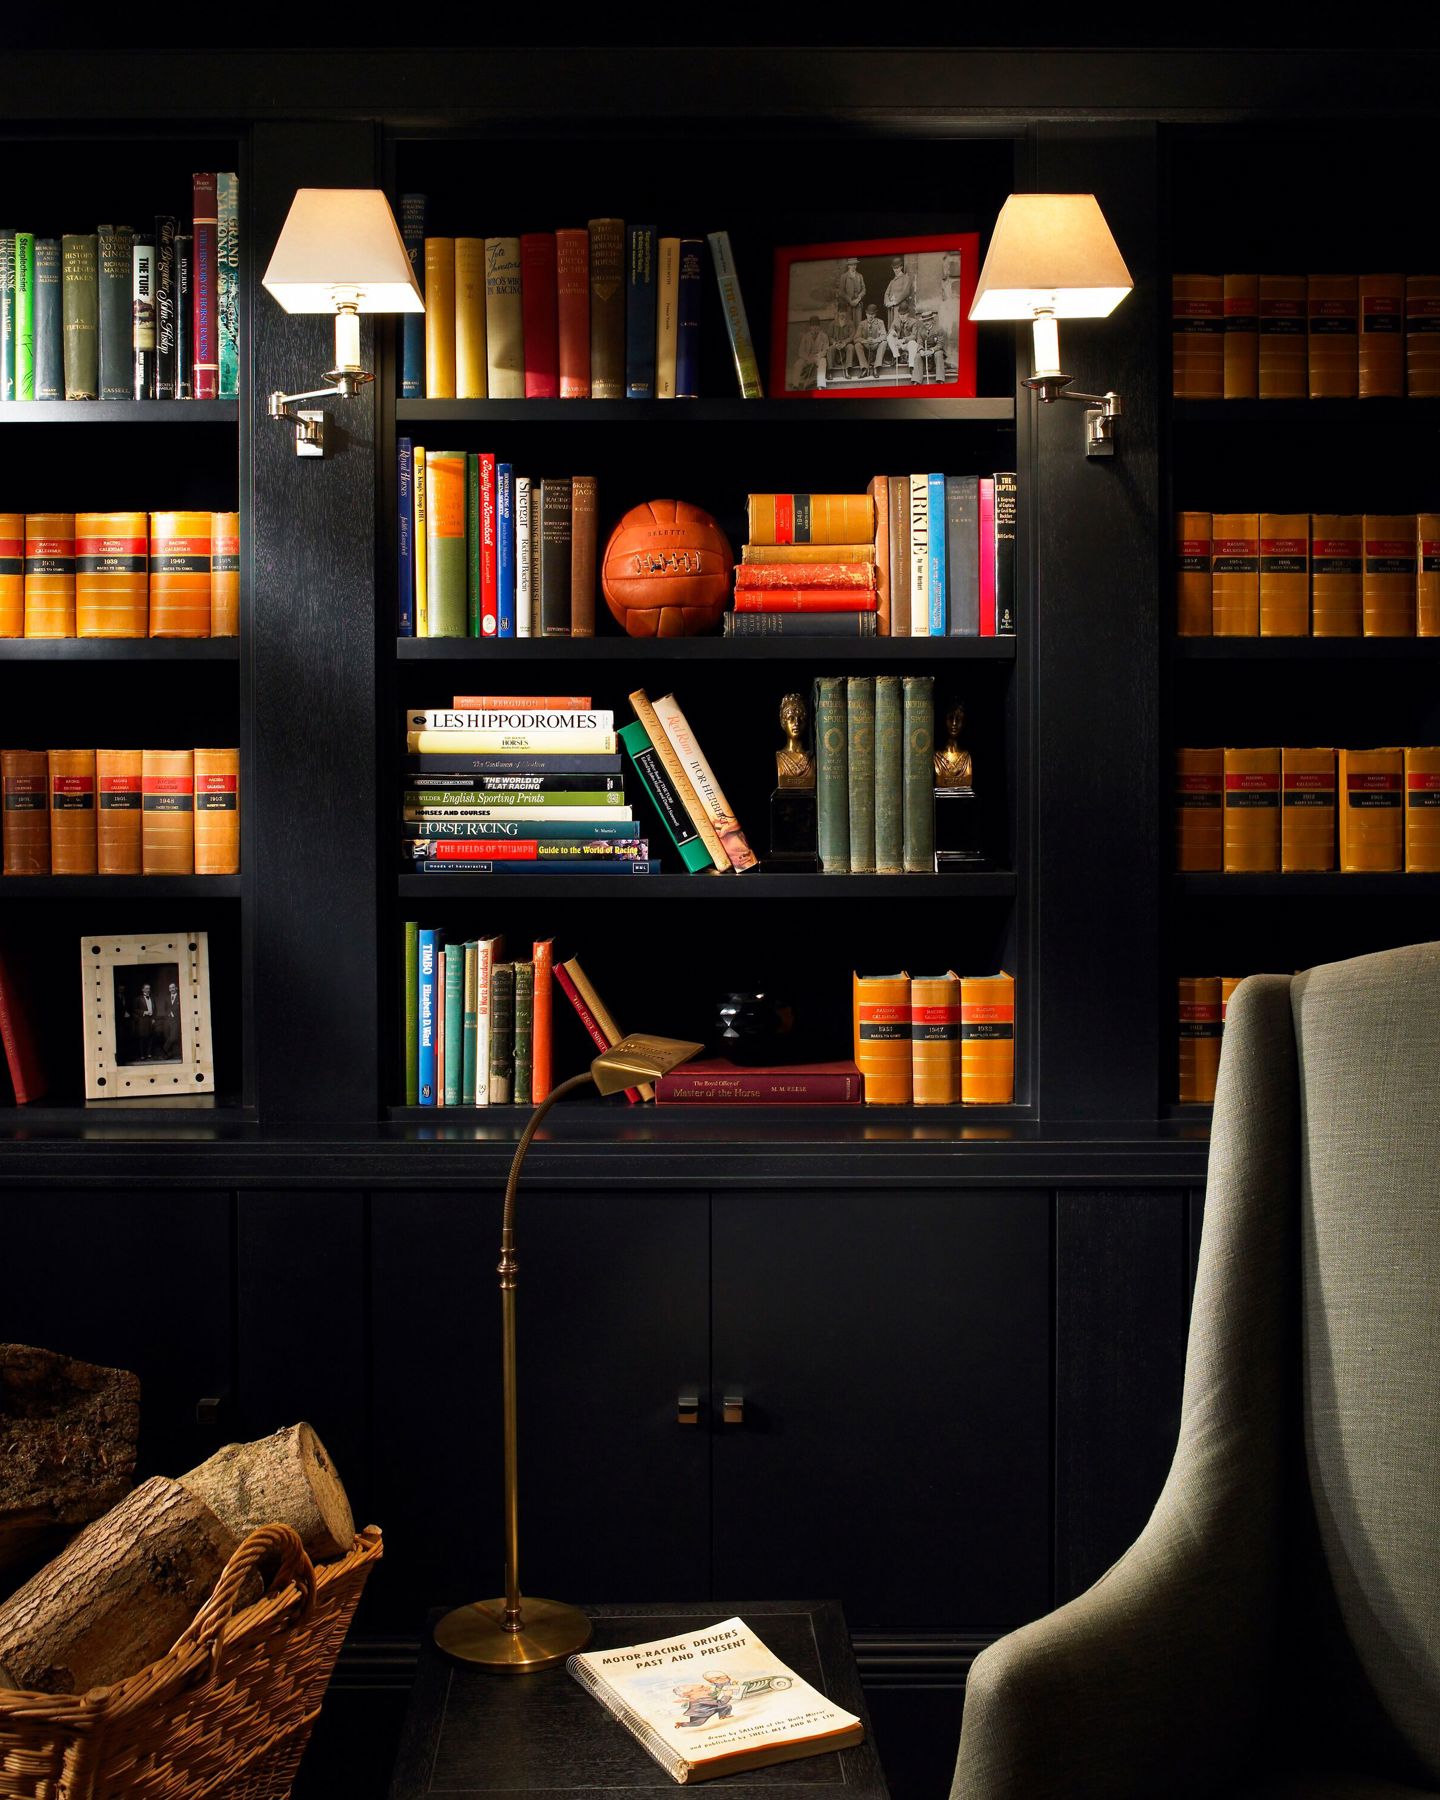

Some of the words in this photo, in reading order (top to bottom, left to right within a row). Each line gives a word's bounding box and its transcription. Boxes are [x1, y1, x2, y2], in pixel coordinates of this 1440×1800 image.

[161, 222, 174, 242] The
[218, 191, 227, 267] NATIONAL
[229, 216, 238, 267] GRAND
[19, 238, 28, 292] Steeplechasing
[139, 258, 149, 273] THE
[158, 246, 174, 292] Brigadier
[139, 275, 149, 296] TURF
[200, 285, 207, 294] OF
[488, 286, 494, 295] IN
[497, 286, 521, 295] RACING
[157, 290, 174, 319] John
[157, 320, 174, 355] Hislop
[399, 449, 410, 470] Royal
[401, 473, 410, 496] Horses
[481, 460, 492, 491] Royalty
[483, 492, 491, 501] on
[519, 482, 530, 528] Shergar
[483, 502, 493, 546] Horseback
[912, 481, 927, 555] ARKLE
[522, 539, 530, 564] Richard
[433, 714, 464, 728] LES
[467, 714, 597, 728] HIPPODROMES
[666, 713, 686, 734] Red
[675, 730, 697, 757] Rum
[688, 759, 708, 785] IVOR
[442, 792, 476, 804] English
[478, 792, 515, 804] Sporting
[517, 793, 544, 803] Prints
[660, 783, 668, 794] THE
[664, 792, 674, 804] TURF
[419, 822, 463, 834] HORSE
[467, 822, 518, 835] RACING
[539, 846, 559, 854] Guide
[583, 846, 604, 854] World
[614, 846, 638, 855] Racing
[422, 944, 432, 974] TIMBO
[422, 984, 432, 1018] Elizabeth
[571, 995, 585, 1011] THE
[580, 1011, 596, 1030] FIRST
[423, 1027, 432, 1046] Ward
[673, 1089, 704, 1097] Master
[705, 1089, 715, 1097] of
[721, 1089, 732, 1097] the
[734, 1089, 760, 1097] Horse
[602, 1644, 687, 1665] MOTOR-RACING
[693, 1629, 738, 1647] DRIVERS
[636, 1659, 663, 1669] PAST
[671, 1653, 694, 1663] AND
[701, 1638, 747, 1656] PRESENT
[739, 1725, 764, 1734] SALLON
[704, 1738, 736, 1748] published
